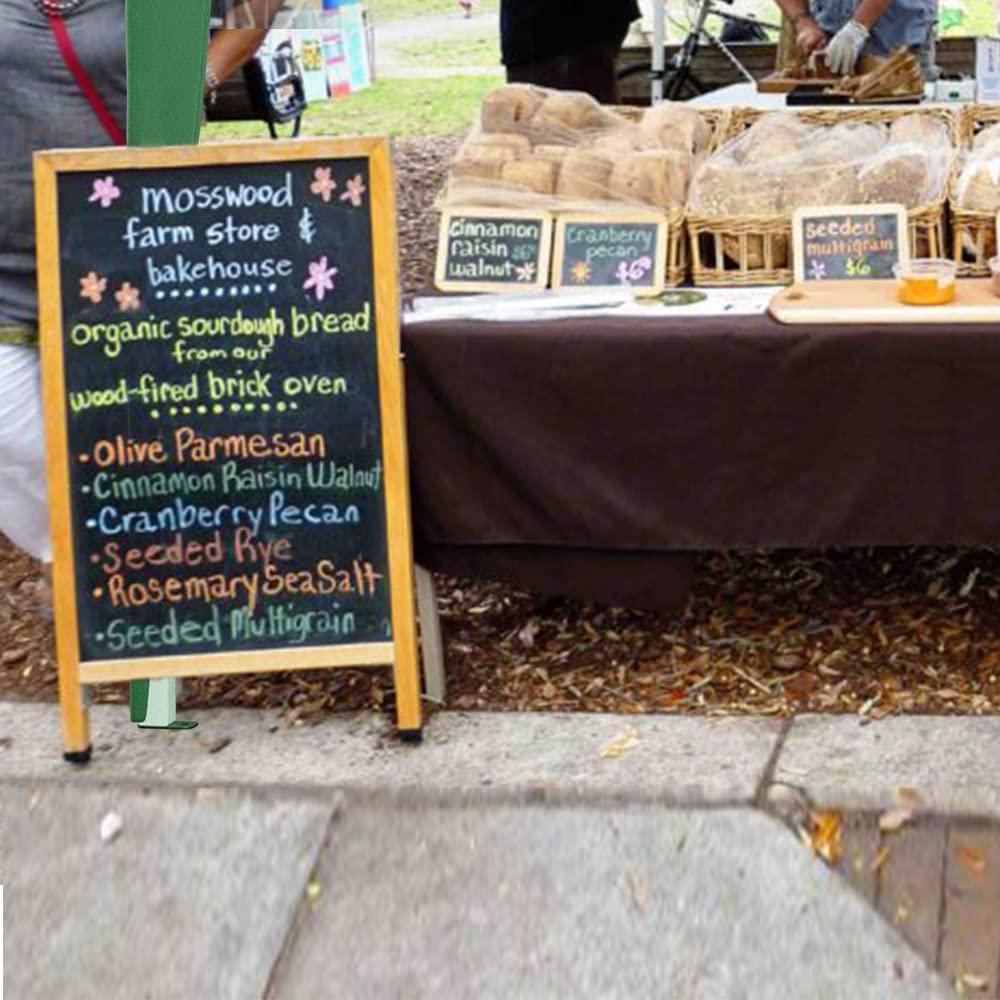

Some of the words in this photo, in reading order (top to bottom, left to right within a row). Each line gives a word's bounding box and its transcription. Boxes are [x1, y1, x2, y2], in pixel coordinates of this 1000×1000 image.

[123, 217, 194, 250] farm
[206, 215, 281, 245] store
[451, 239, 509, 258] raisin
[146, 254, 293, 287] bakehouse
[449, 257, 518, 278] walnut
[71, 315, 173, 357] organic
[177, 307, 284, 347] sourdough
[291, 302, 371, 338] bread
[172, 341, 227, 364] from
[232, 346, 273, 361] our
[70, 374, 199, 413] wood-fired
[207, 369, 272, 399] brick
[283, 374, 348, 395] oven
[93, 435, 168, 467] Olive
[174, 427, 326, 463] Parmesan
[93, 471, 215, 501] Cinnamon
[221, 460, 301, 494] Raisin
[306, 459, 382, 490] Walnut
[98, 498, 263, 538] Cranberry
[268, 490, 360, 527] Pecan
[103, 530, 222, 574] Seeded
[233, 526, 293, 567] Rye
[108, 572, 259, 617] Rosemary
[106, 605, 221, 651] Seeded
[230, 603, 356, 645] Multigrain
